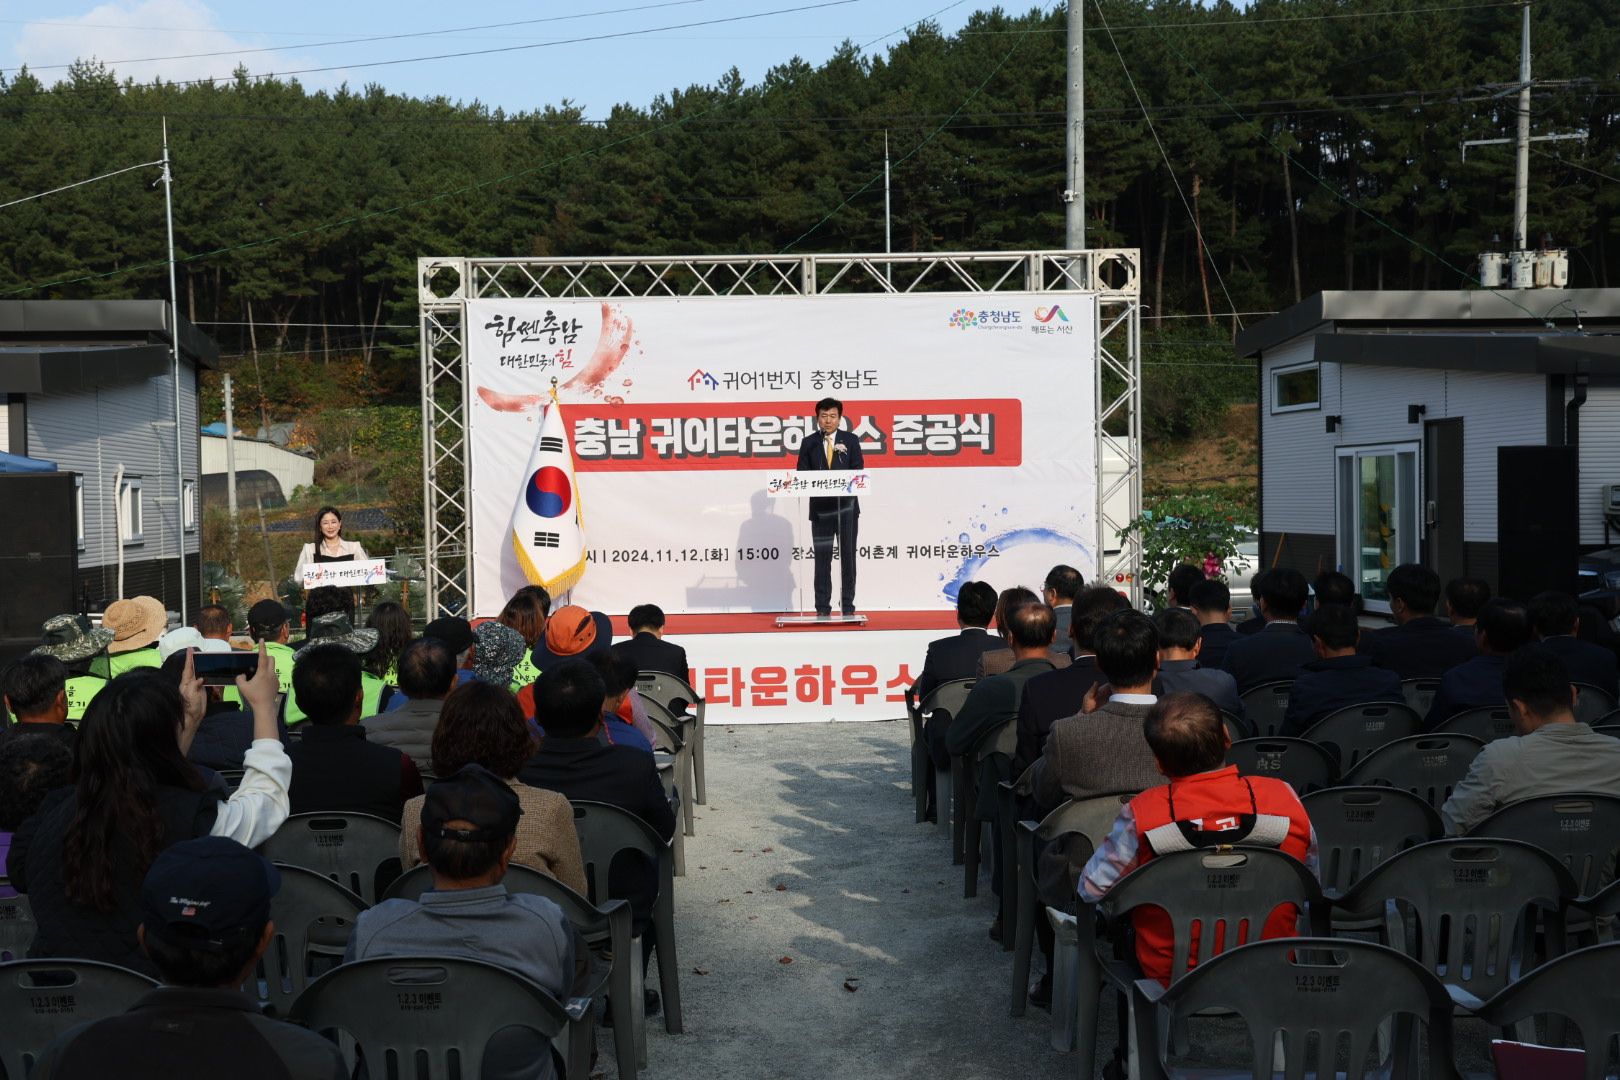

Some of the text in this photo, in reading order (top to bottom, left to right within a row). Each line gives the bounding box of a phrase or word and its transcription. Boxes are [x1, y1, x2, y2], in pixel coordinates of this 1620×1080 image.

[978, 310, 1021, 323] 충청남도
[485, 310, 582, 348] 힘쎈충남
[1031, 325, 1073, 334] 해뜨는 서산
[555, 349, 574, 370] 힘
[723, 369, 879, 391] 귀어1번지 충청남도
[574, 412, 995, 459] 충남 귀어타운하스 준공식
[737, 547, 780, 561] 15:00
[906, 544, 1000, 559] 귀어타운하우스
[688, 664, 919, 707] 타운하우스
